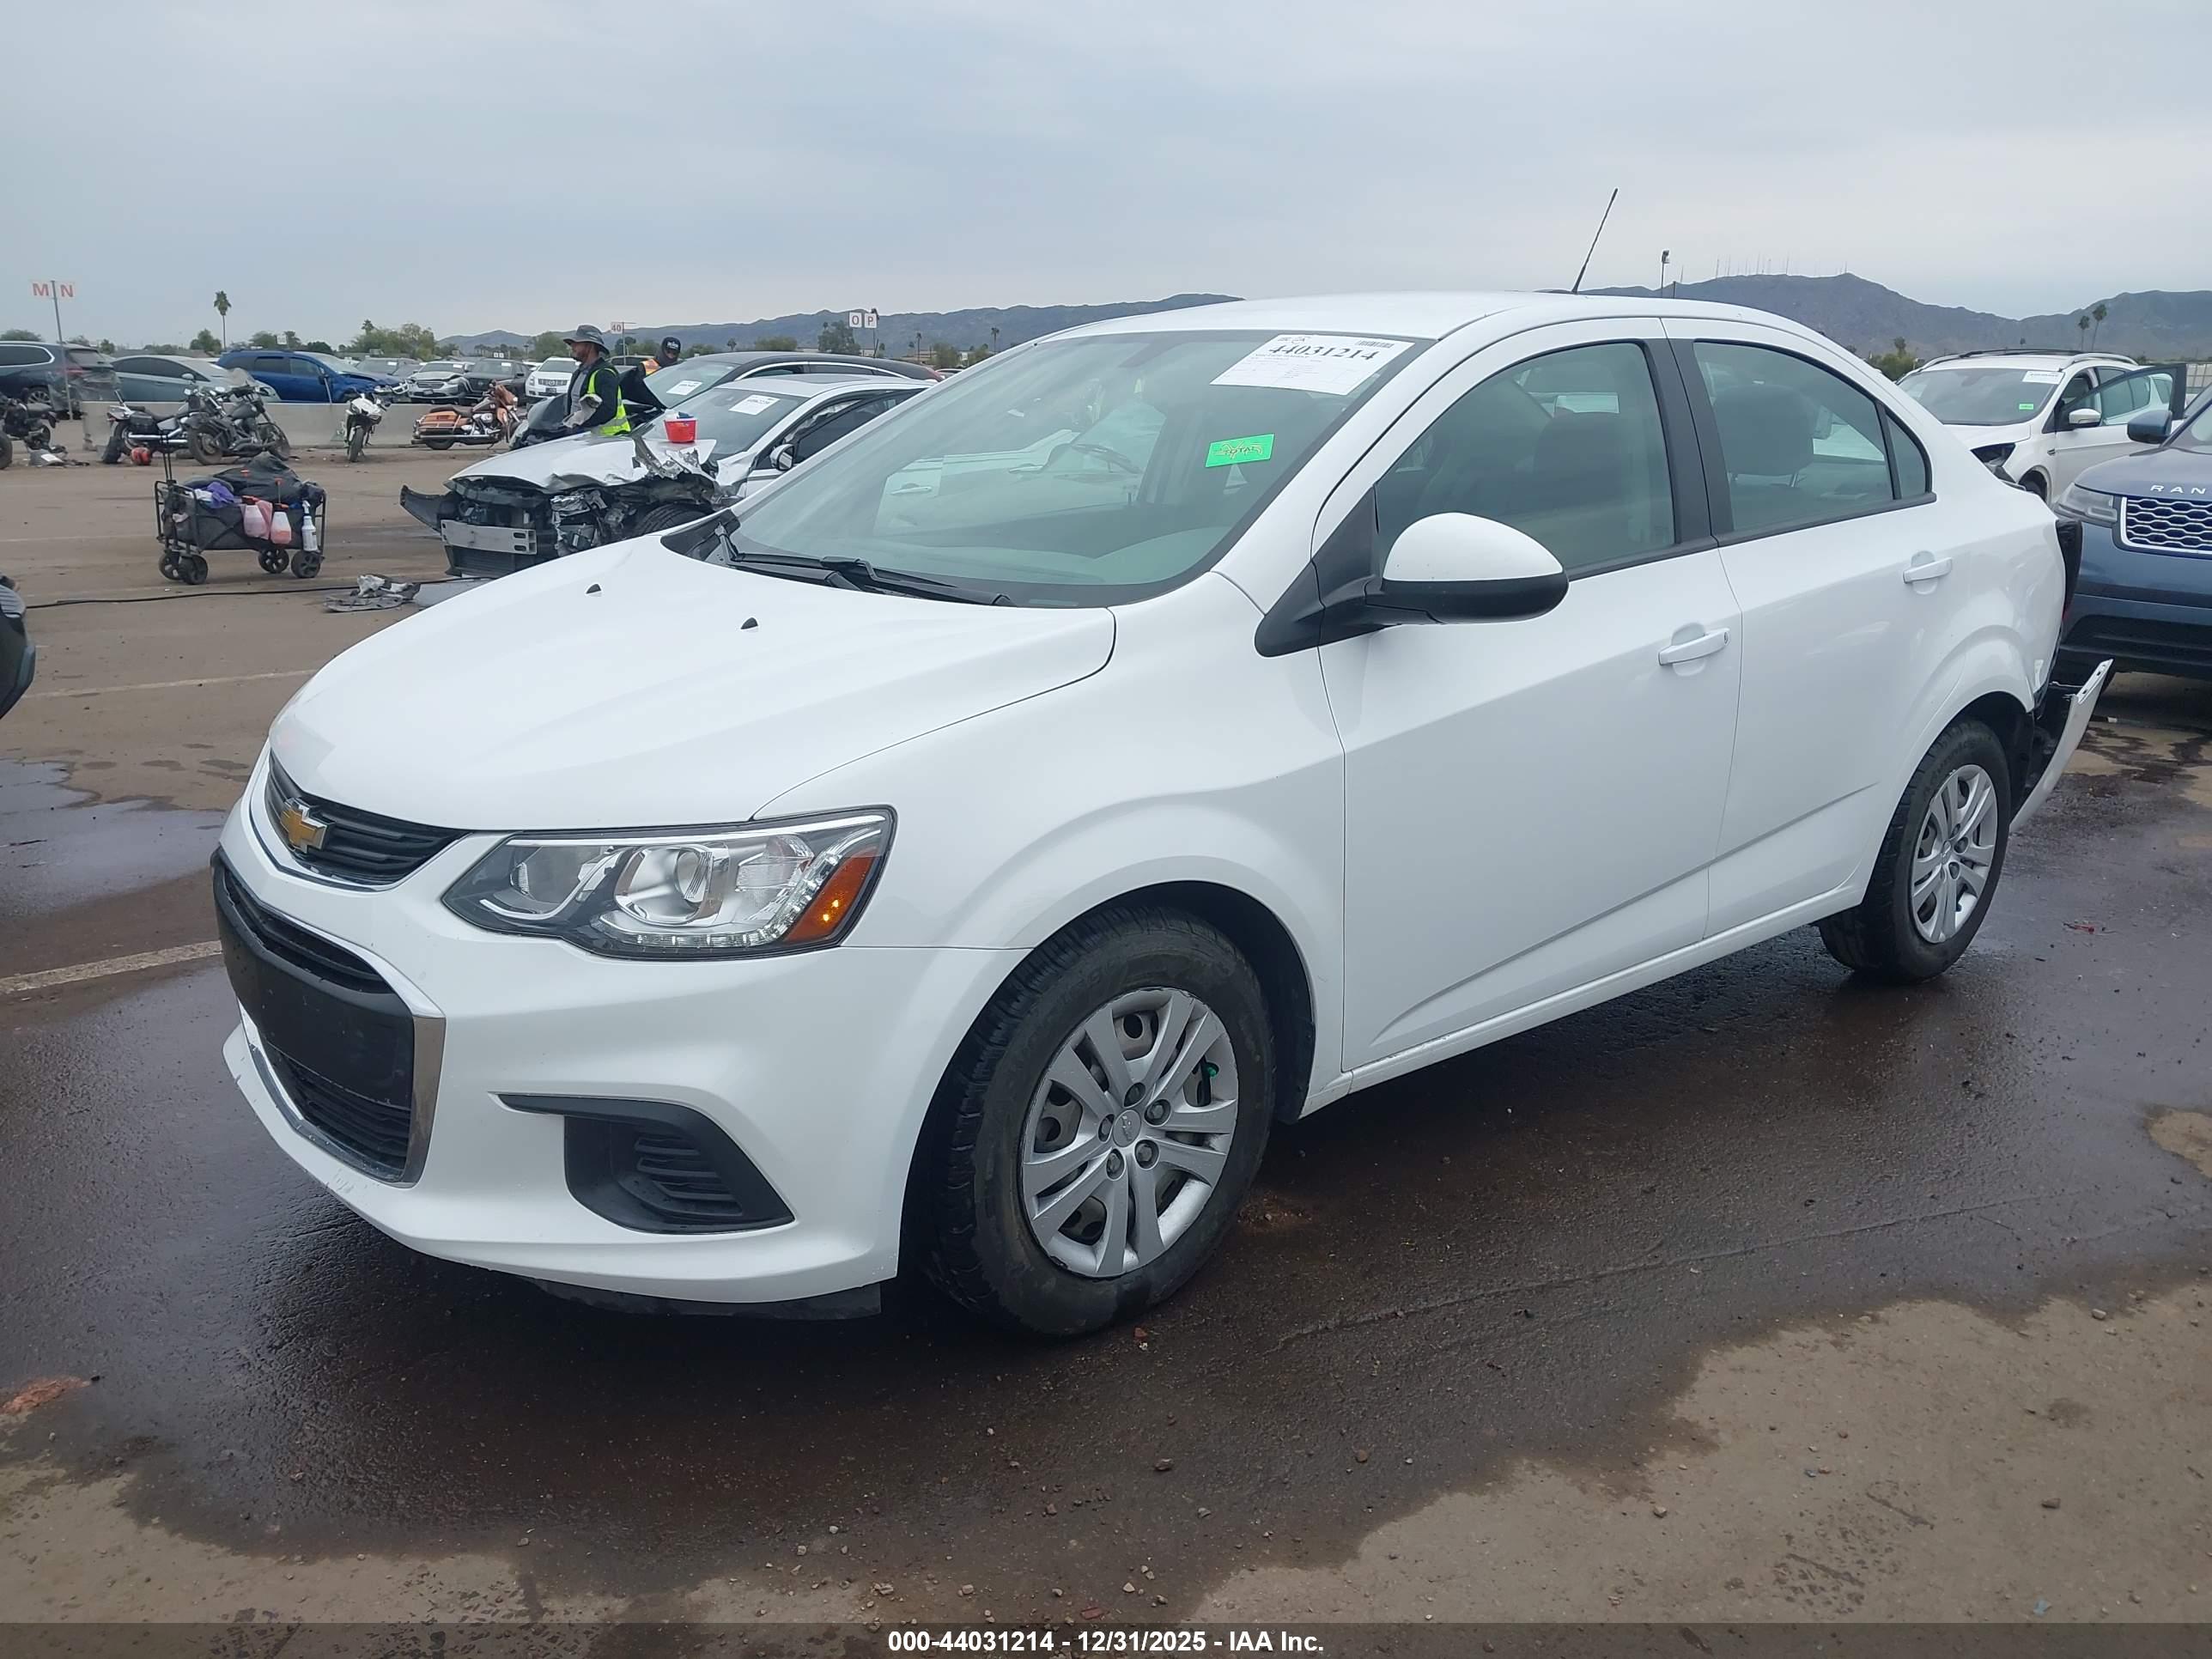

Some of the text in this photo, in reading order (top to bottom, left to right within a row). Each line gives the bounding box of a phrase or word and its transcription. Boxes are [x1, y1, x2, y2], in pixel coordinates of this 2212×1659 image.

[33, 283, 74, 298] M N
[852, 315, 874, 326] O P
[1268, 344, 1379, 361] 44031214
[2150, 484, 2206, 495] RAN
